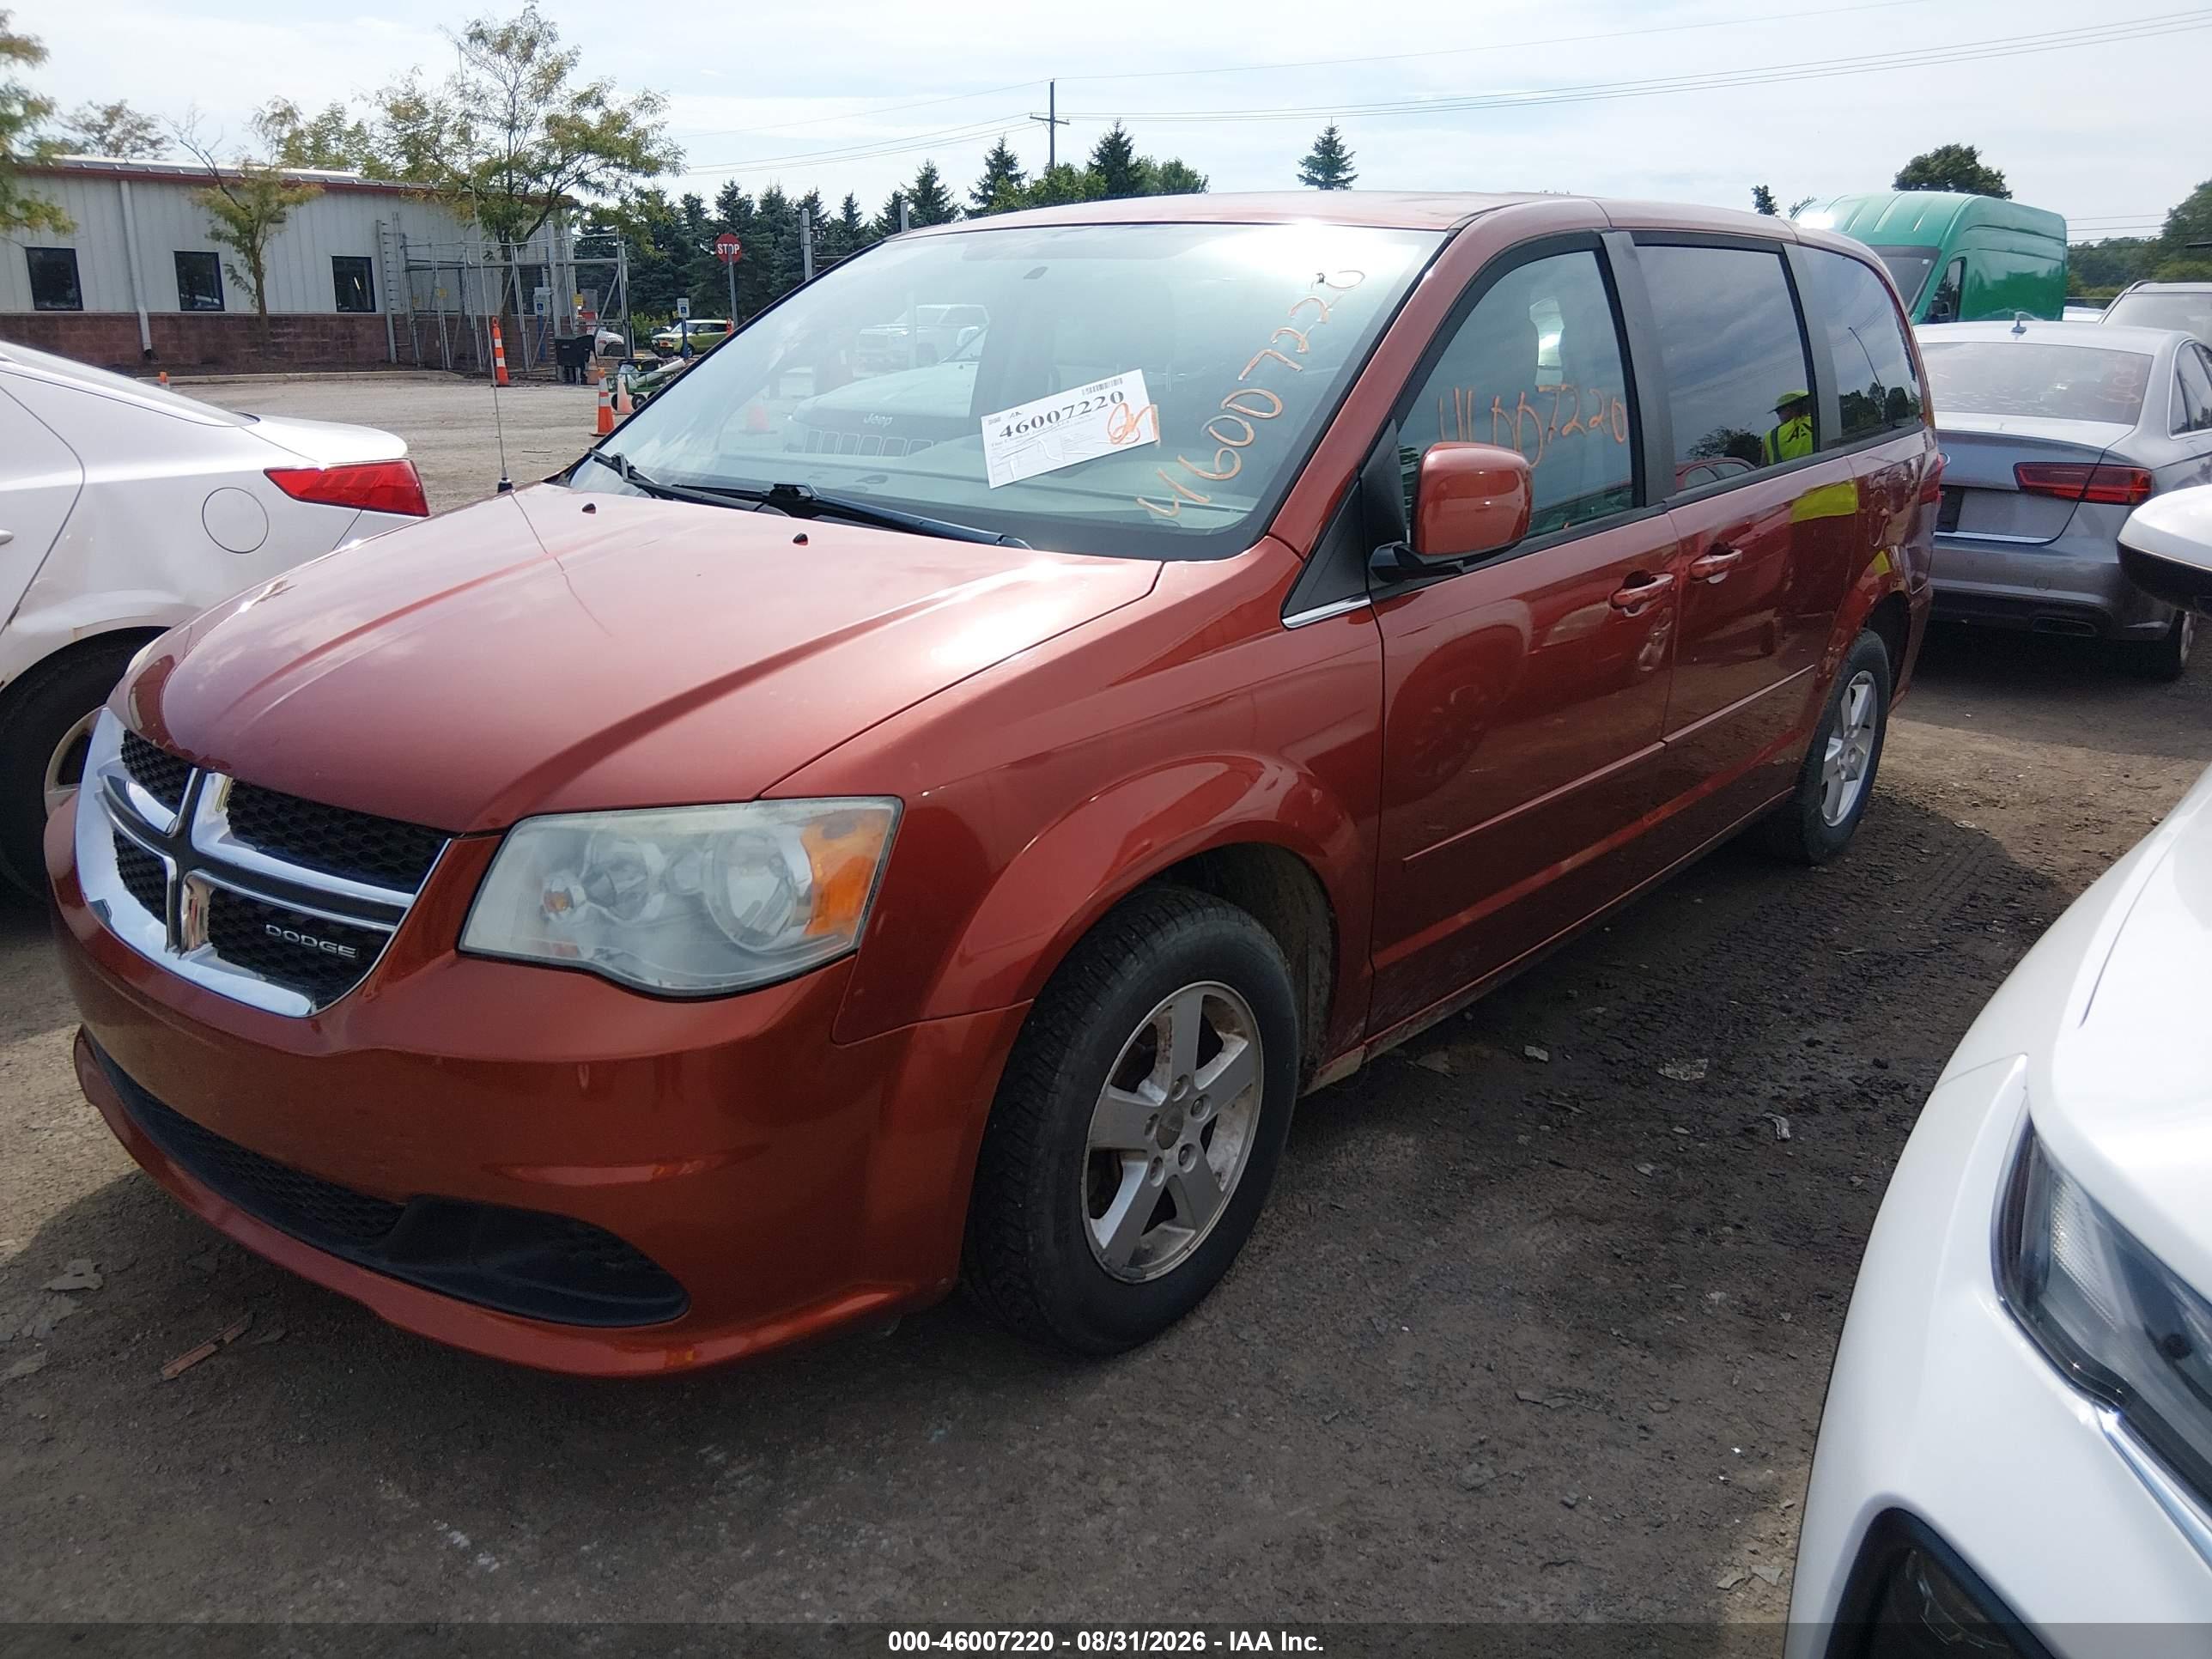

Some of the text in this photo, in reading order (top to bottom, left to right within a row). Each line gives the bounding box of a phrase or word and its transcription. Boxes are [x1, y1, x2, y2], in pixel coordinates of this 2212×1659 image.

[863, 412, 894, 428] Jeep
[999, 391, 1125, 438] 46007220
[265, 924, 357, 958] DODGE
